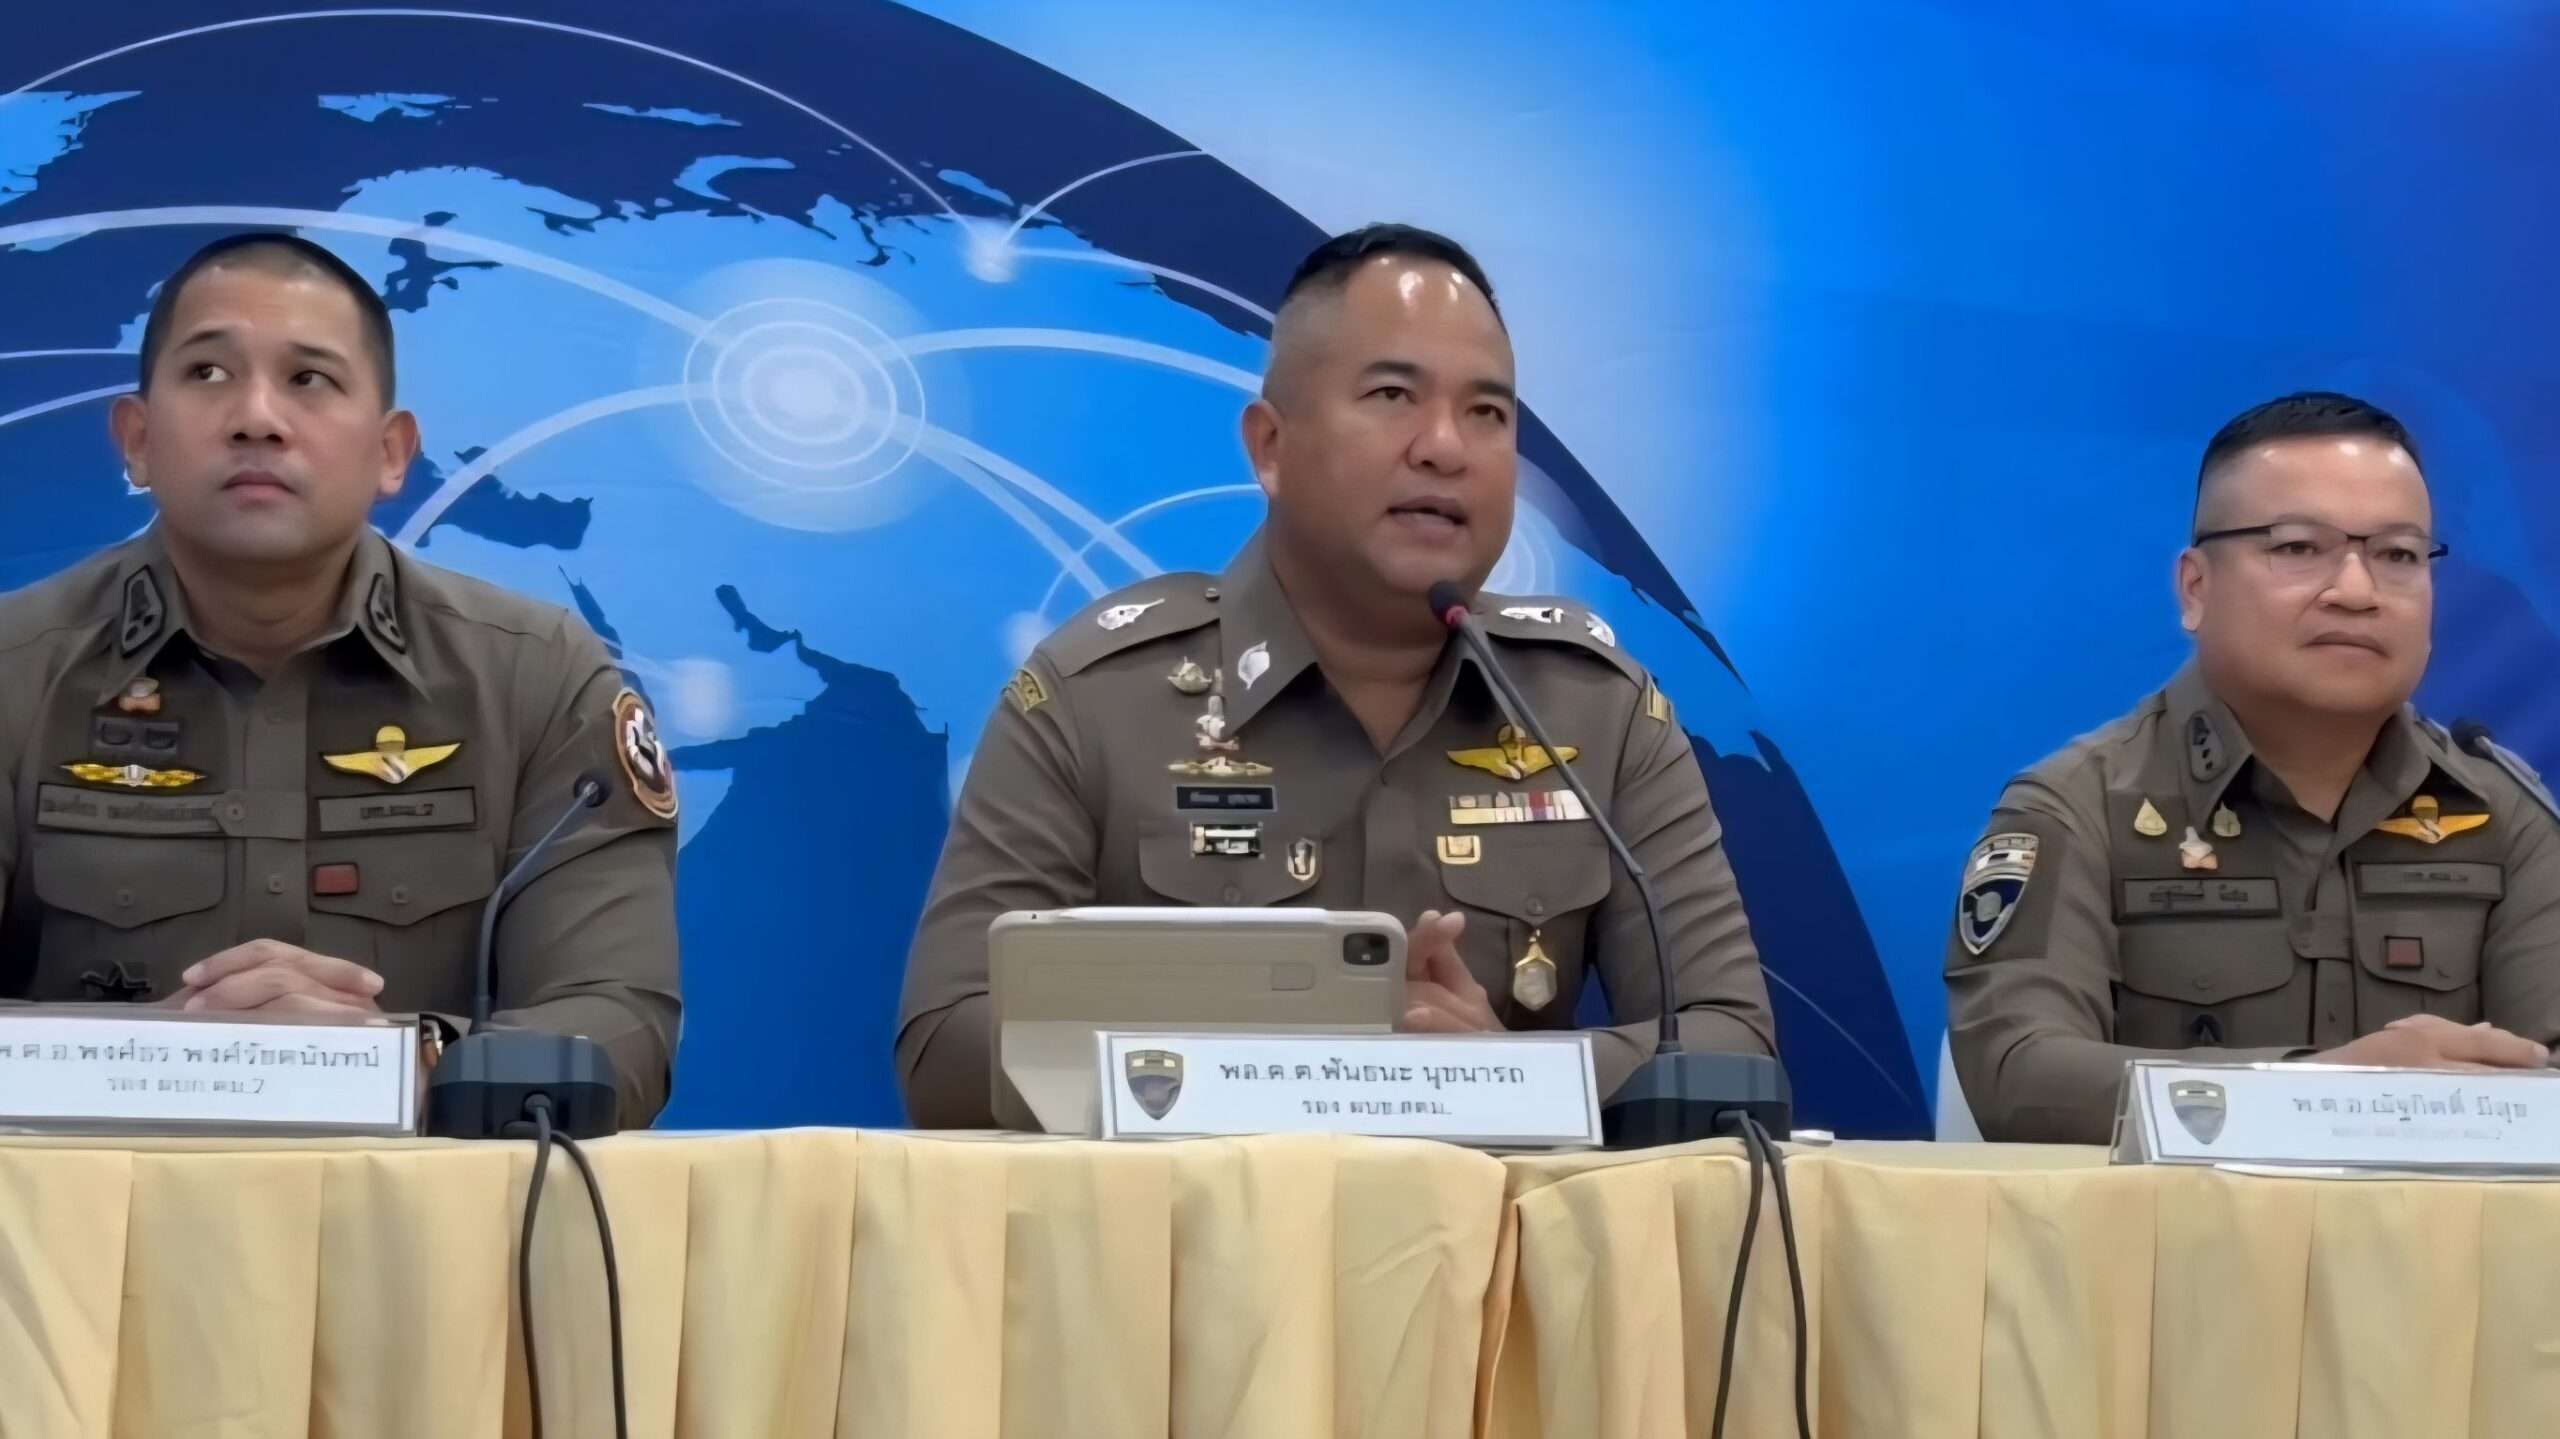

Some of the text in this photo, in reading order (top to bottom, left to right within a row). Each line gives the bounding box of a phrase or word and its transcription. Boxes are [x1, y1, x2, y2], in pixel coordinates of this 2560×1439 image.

[1423, 1065, 1525, 1090] นุชนารถ
[1302, 1100, 1340, 1115] รอง
